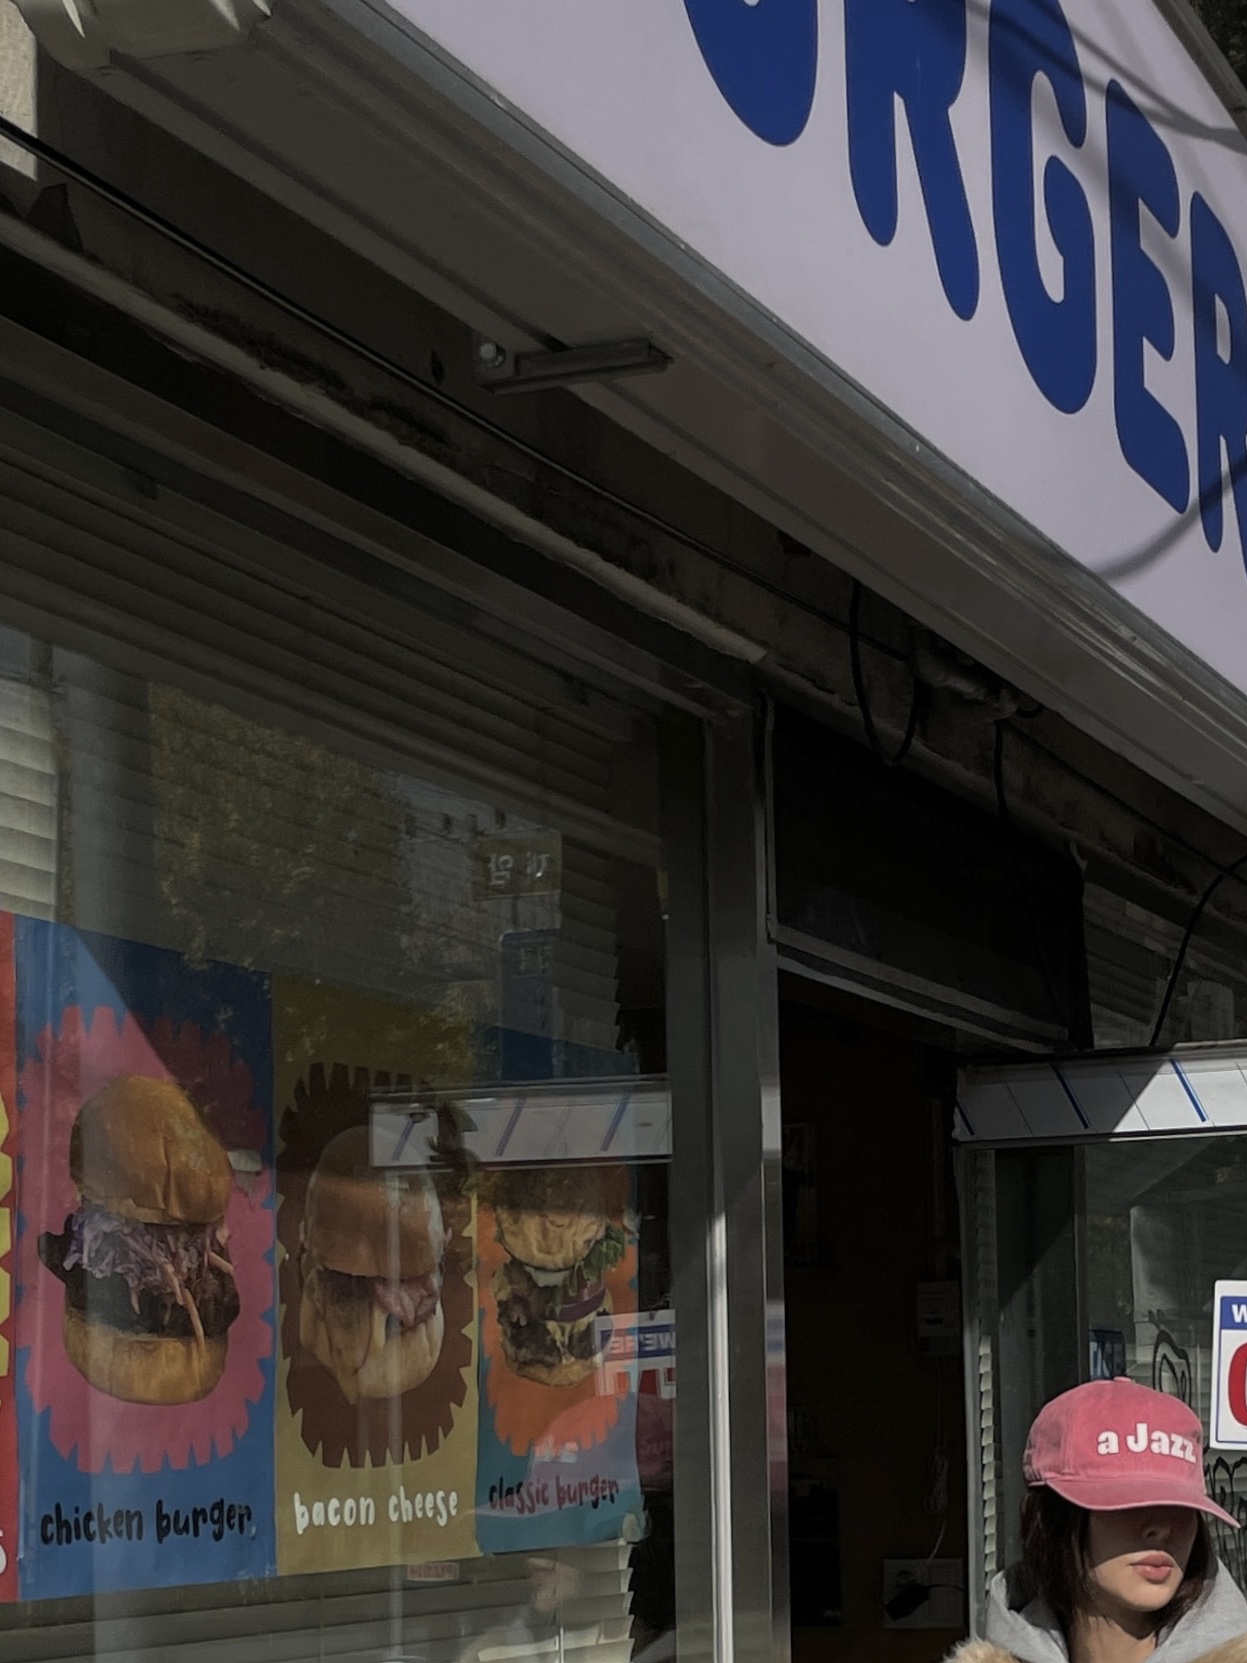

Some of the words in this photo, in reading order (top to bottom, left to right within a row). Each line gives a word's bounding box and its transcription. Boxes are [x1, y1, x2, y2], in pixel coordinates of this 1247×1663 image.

[1097, 1430, 1120, 1456] a
[1126, 1422, 1197, 1465] Jazz
[293, 1490, 376, 1535] bacon
[388, 1485, 459, 1527] cheese
[488, 1476, 550, 1515] classic
[555, 1474, 620, 1512] burger
[40, 1501, 144, 1546] chicken
[155, 1497, 252, 1545] burger
